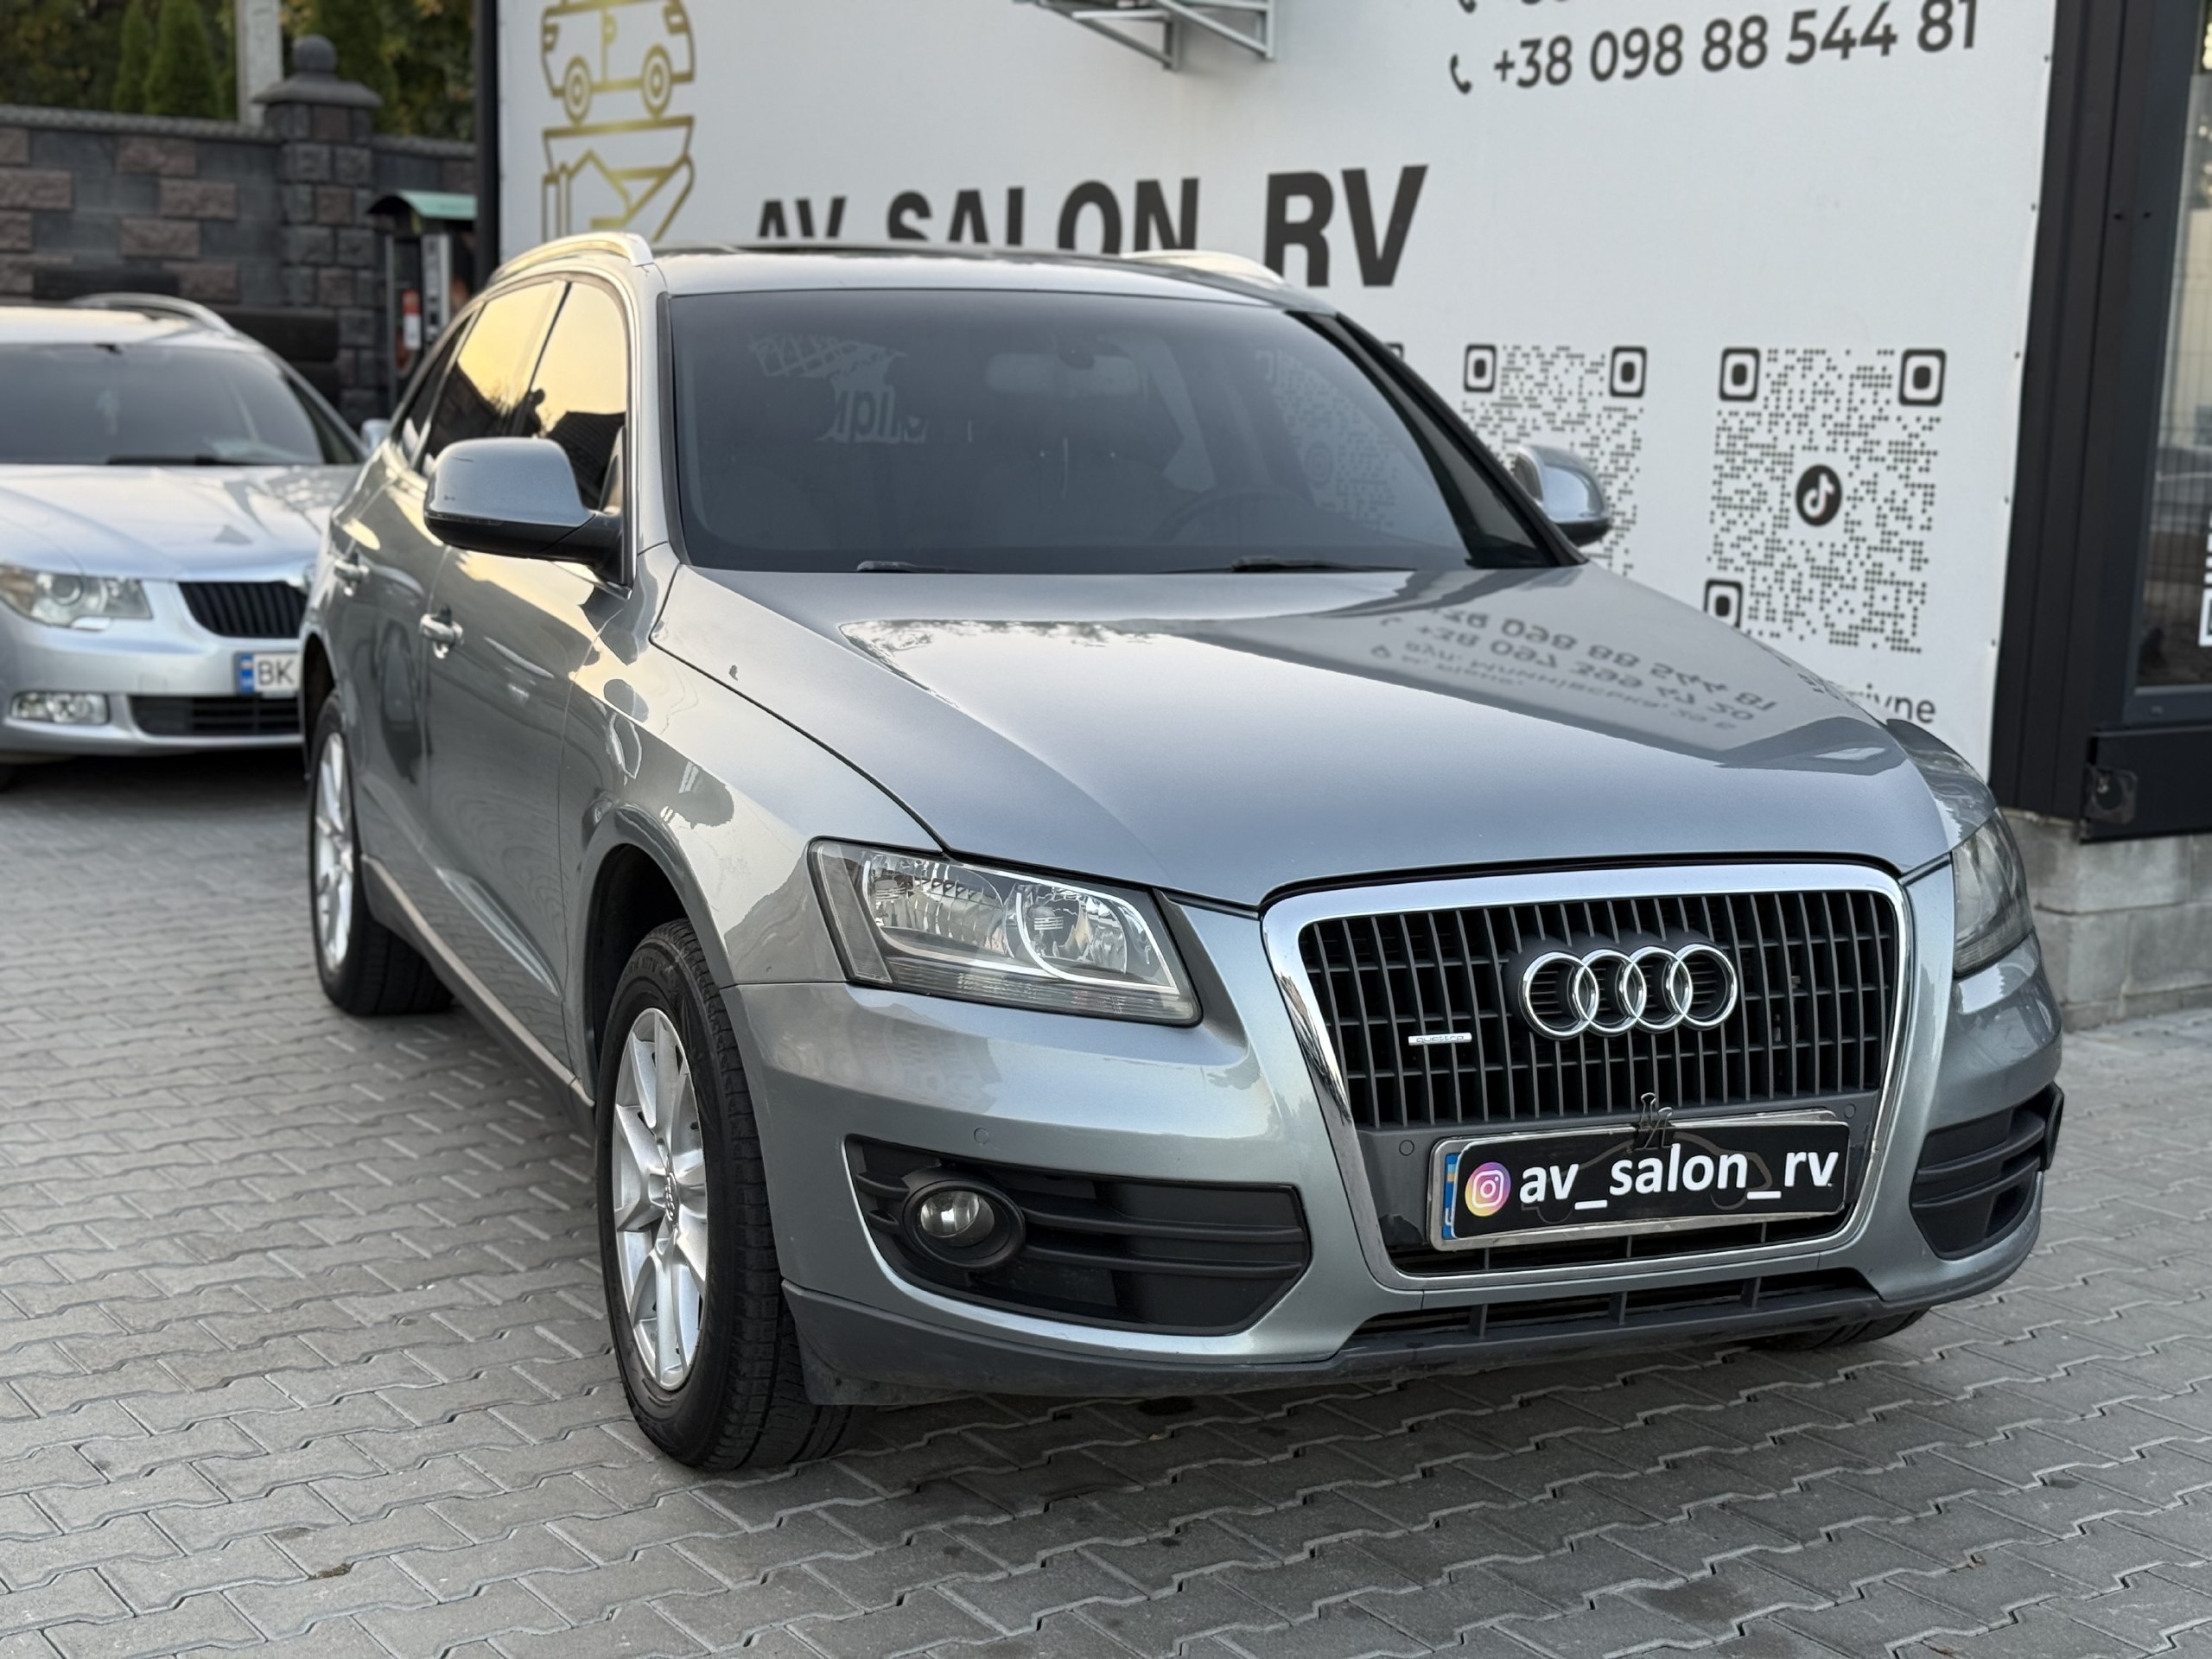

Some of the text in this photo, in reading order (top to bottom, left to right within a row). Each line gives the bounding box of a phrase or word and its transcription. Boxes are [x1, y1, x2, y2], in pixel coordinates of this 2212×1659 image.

[1493, 0, 1978, 88] +38 098 88 544 81
[1263, 164, 1430, 288] RV
[258, 659, 295, 686] BK
[1416, 1035, 1465, 1044] quattro
[1518, 1142, 1840, 1211] av_salon_rv
